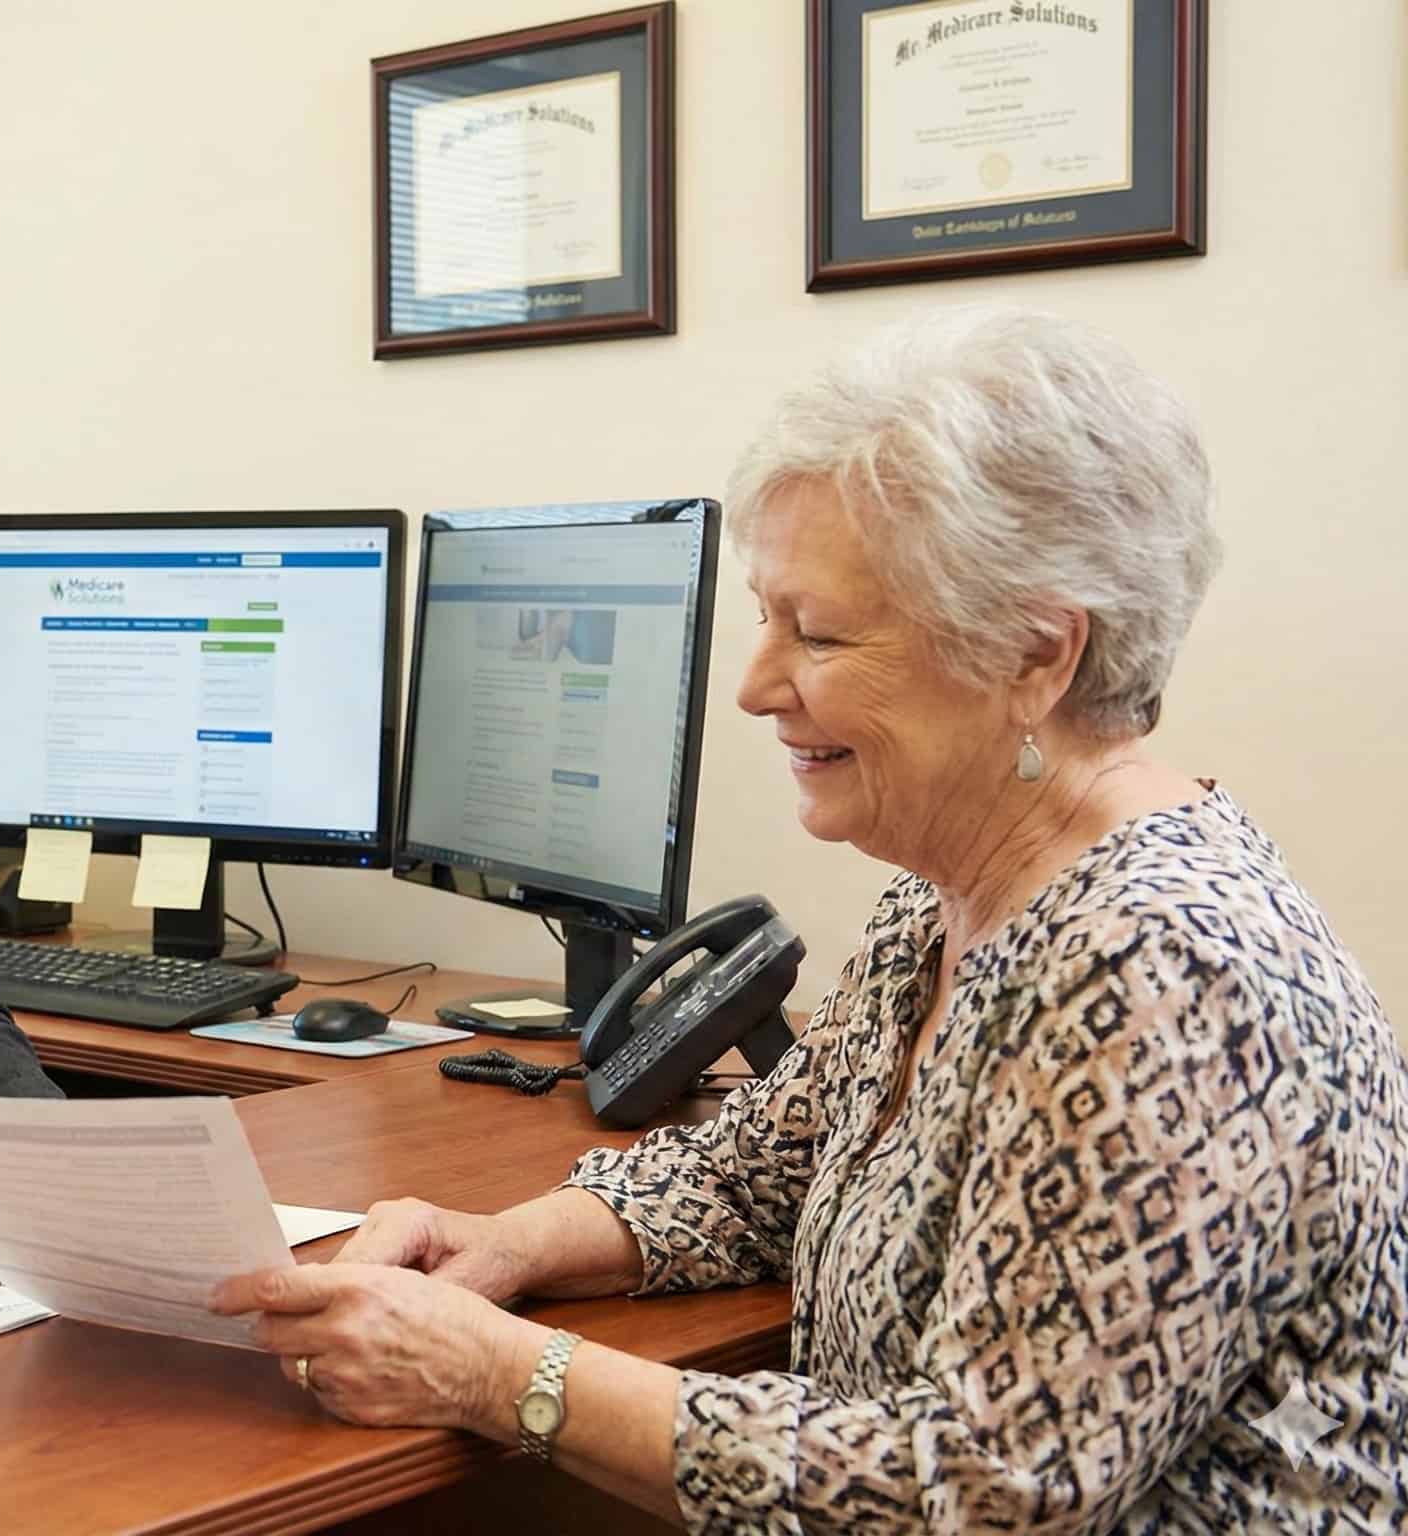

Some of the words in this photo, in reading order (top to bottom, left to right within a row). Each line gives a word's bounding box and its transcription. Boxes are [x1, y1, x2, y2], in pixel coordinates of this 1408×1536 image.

[928, 12, 1003, 48] Medicare
[1008, 0, 1098, 34] Solutions
[67, 578, 125, 592] Medicare
